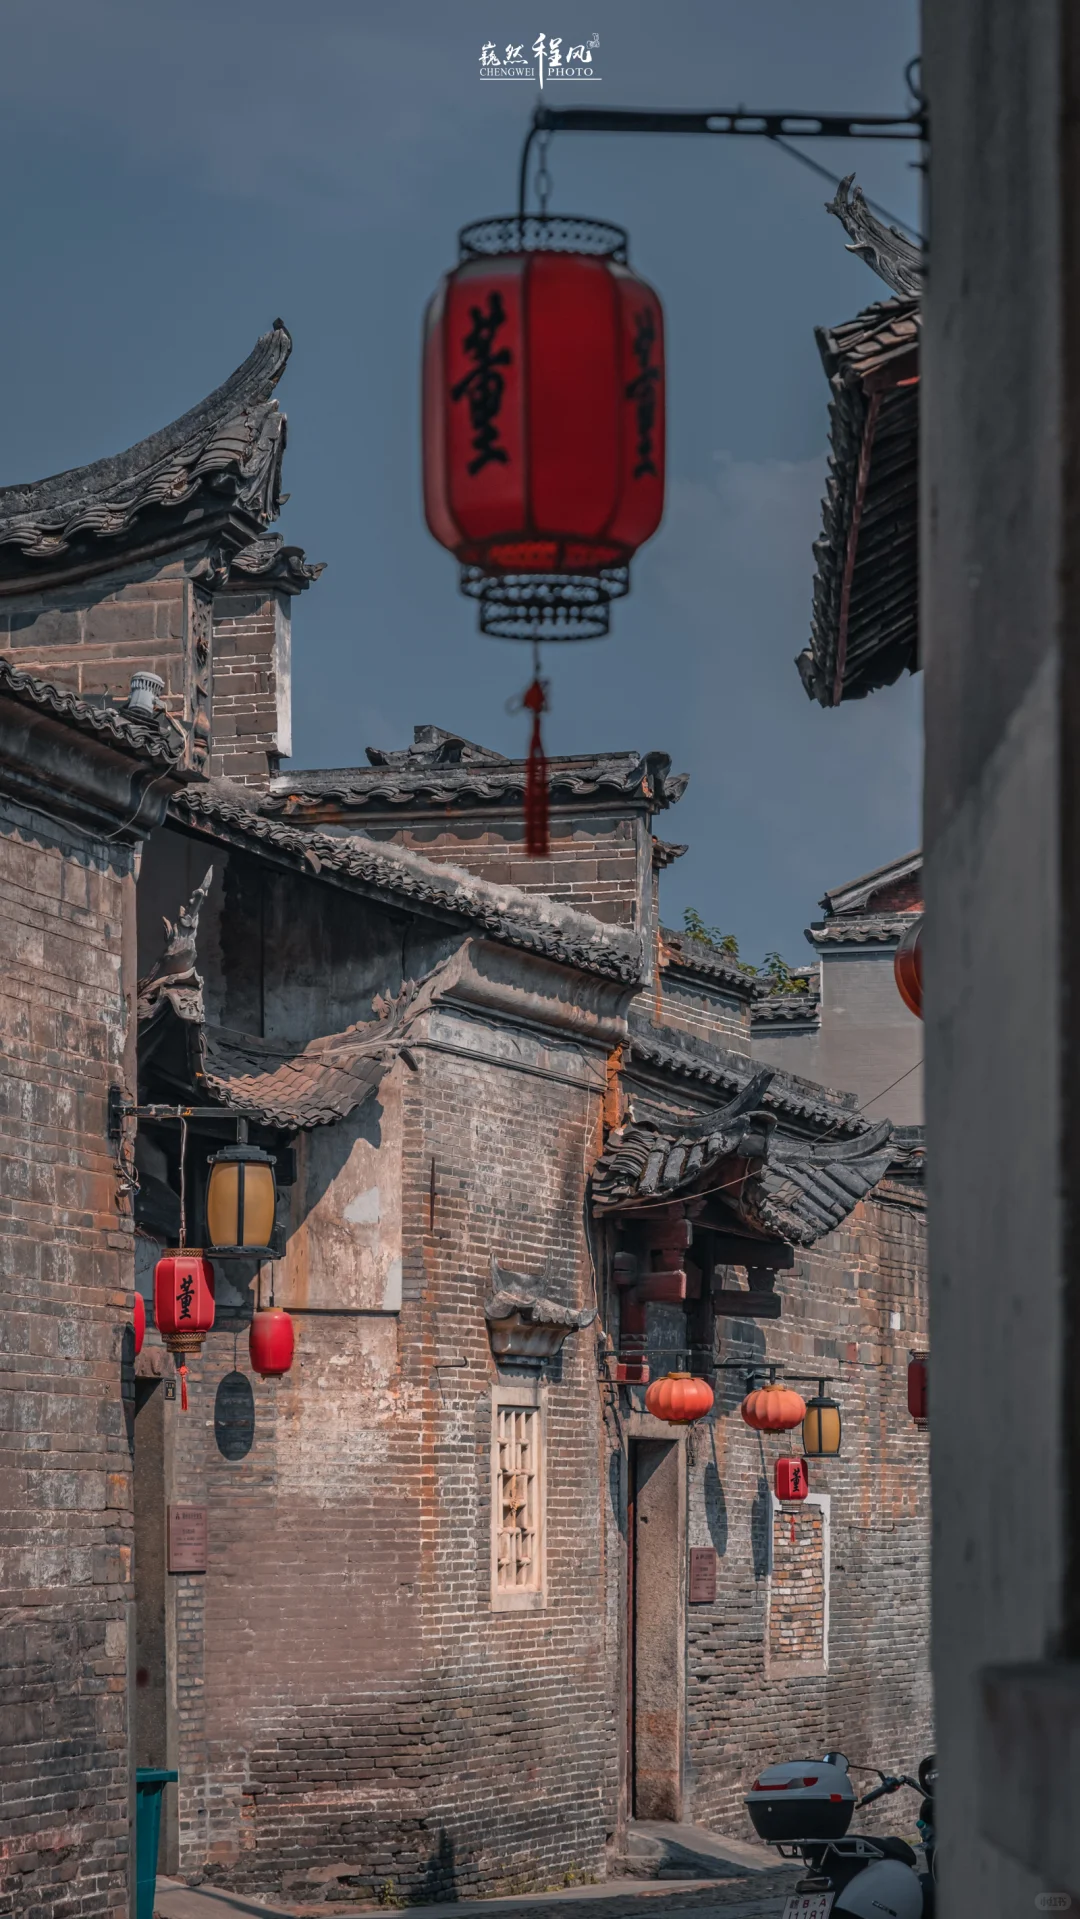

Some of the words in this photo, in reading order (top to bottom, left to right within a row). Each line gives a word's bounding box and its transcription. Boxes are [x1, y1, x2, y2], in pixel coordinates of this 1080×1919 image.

[452, 291, 513, 478] 董
[176, 1274, 195, 1320] 董
[790, 1467, 801, 1493] 董
